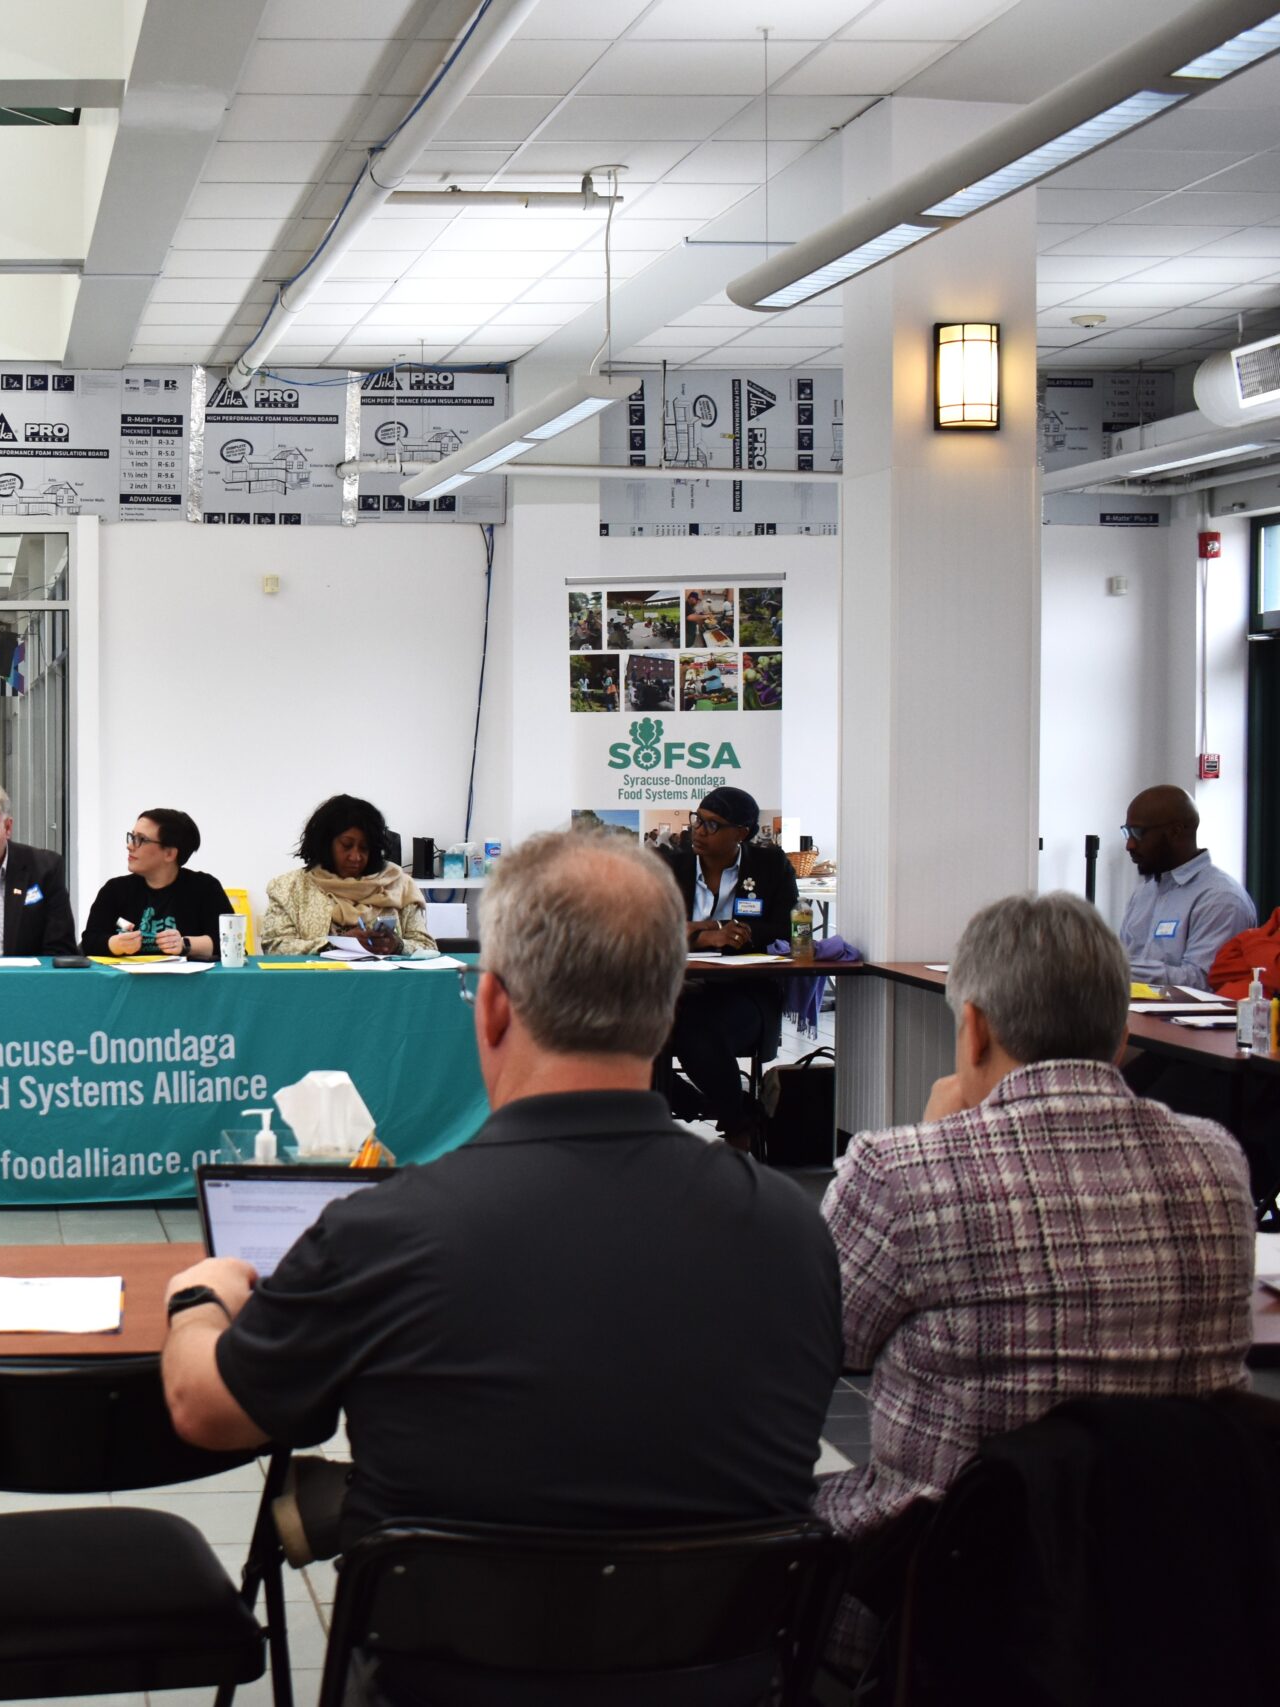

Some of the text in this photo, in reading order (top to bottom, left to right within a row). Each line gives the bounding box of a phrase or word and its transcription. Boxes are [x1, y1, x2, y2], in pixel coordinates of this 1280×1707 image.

[410, 371, 454, 384] PRO
[220, 388, 243, 405] Sika
[254, 389, 299, 403] PRO
[750, 393, 767, 416] Sika
[157, 416, 177, 424] Plus-3
[25, 423, 69, 437] PRO
[753, 428, 767, 470] PRO
[608, 741, 742, 771] SOFSA
[623, 774, 726, 788] Syracuse-Onondaga
[618, 788, 642, 800] Food
[645, 788, 688, 802] Systems
[19, 1074, 145, 1116] Systems
[152, 1070, 268, 1105] Alliance
